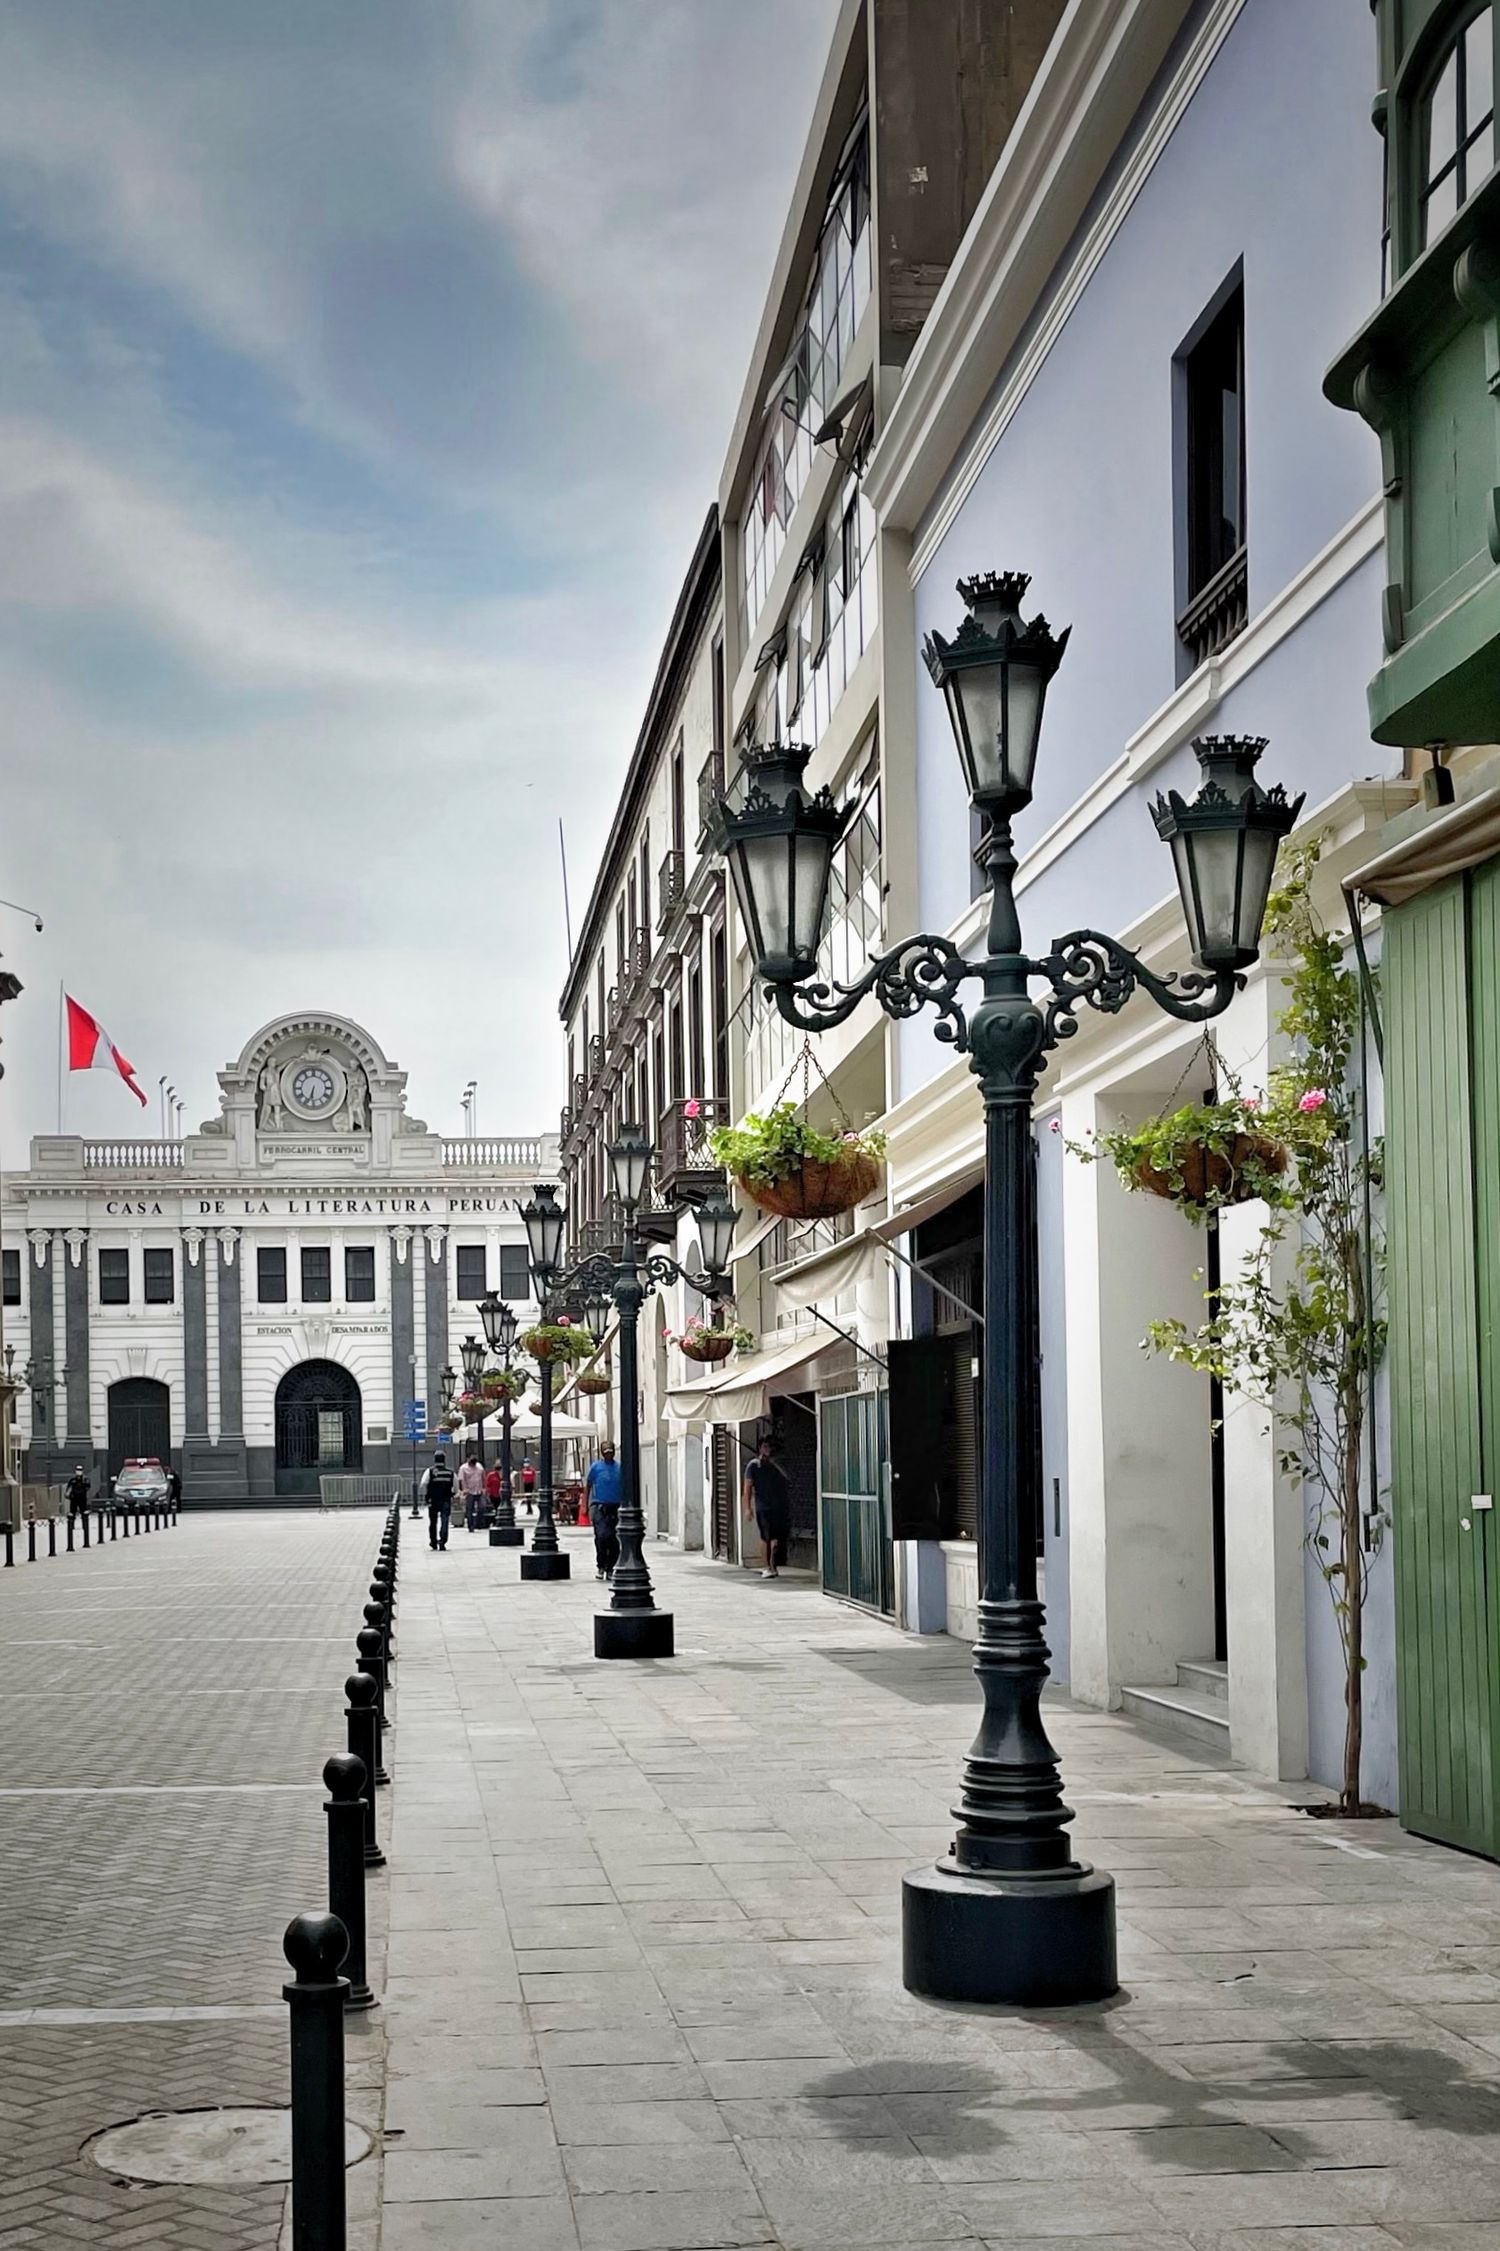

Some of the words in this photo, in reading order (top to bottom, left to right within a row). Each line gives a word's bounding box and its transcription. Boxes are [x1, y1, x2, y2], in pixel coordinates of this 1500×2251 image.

[264, 1146, 321, 1154] FERROCARRIL
[326, 1146, 364, 1154] CENTRAL
[106, 1201, 163, 1214] CASA
[199, 1201, 225, 1213] DE
[244, 1201, 270, 1213] LA
[288, 1200, 431, 1213] LITERATURA
[449, 1199, 525, 1211] PERUAN
[332, 1326, 388, 1334] DESAMPARADOS
